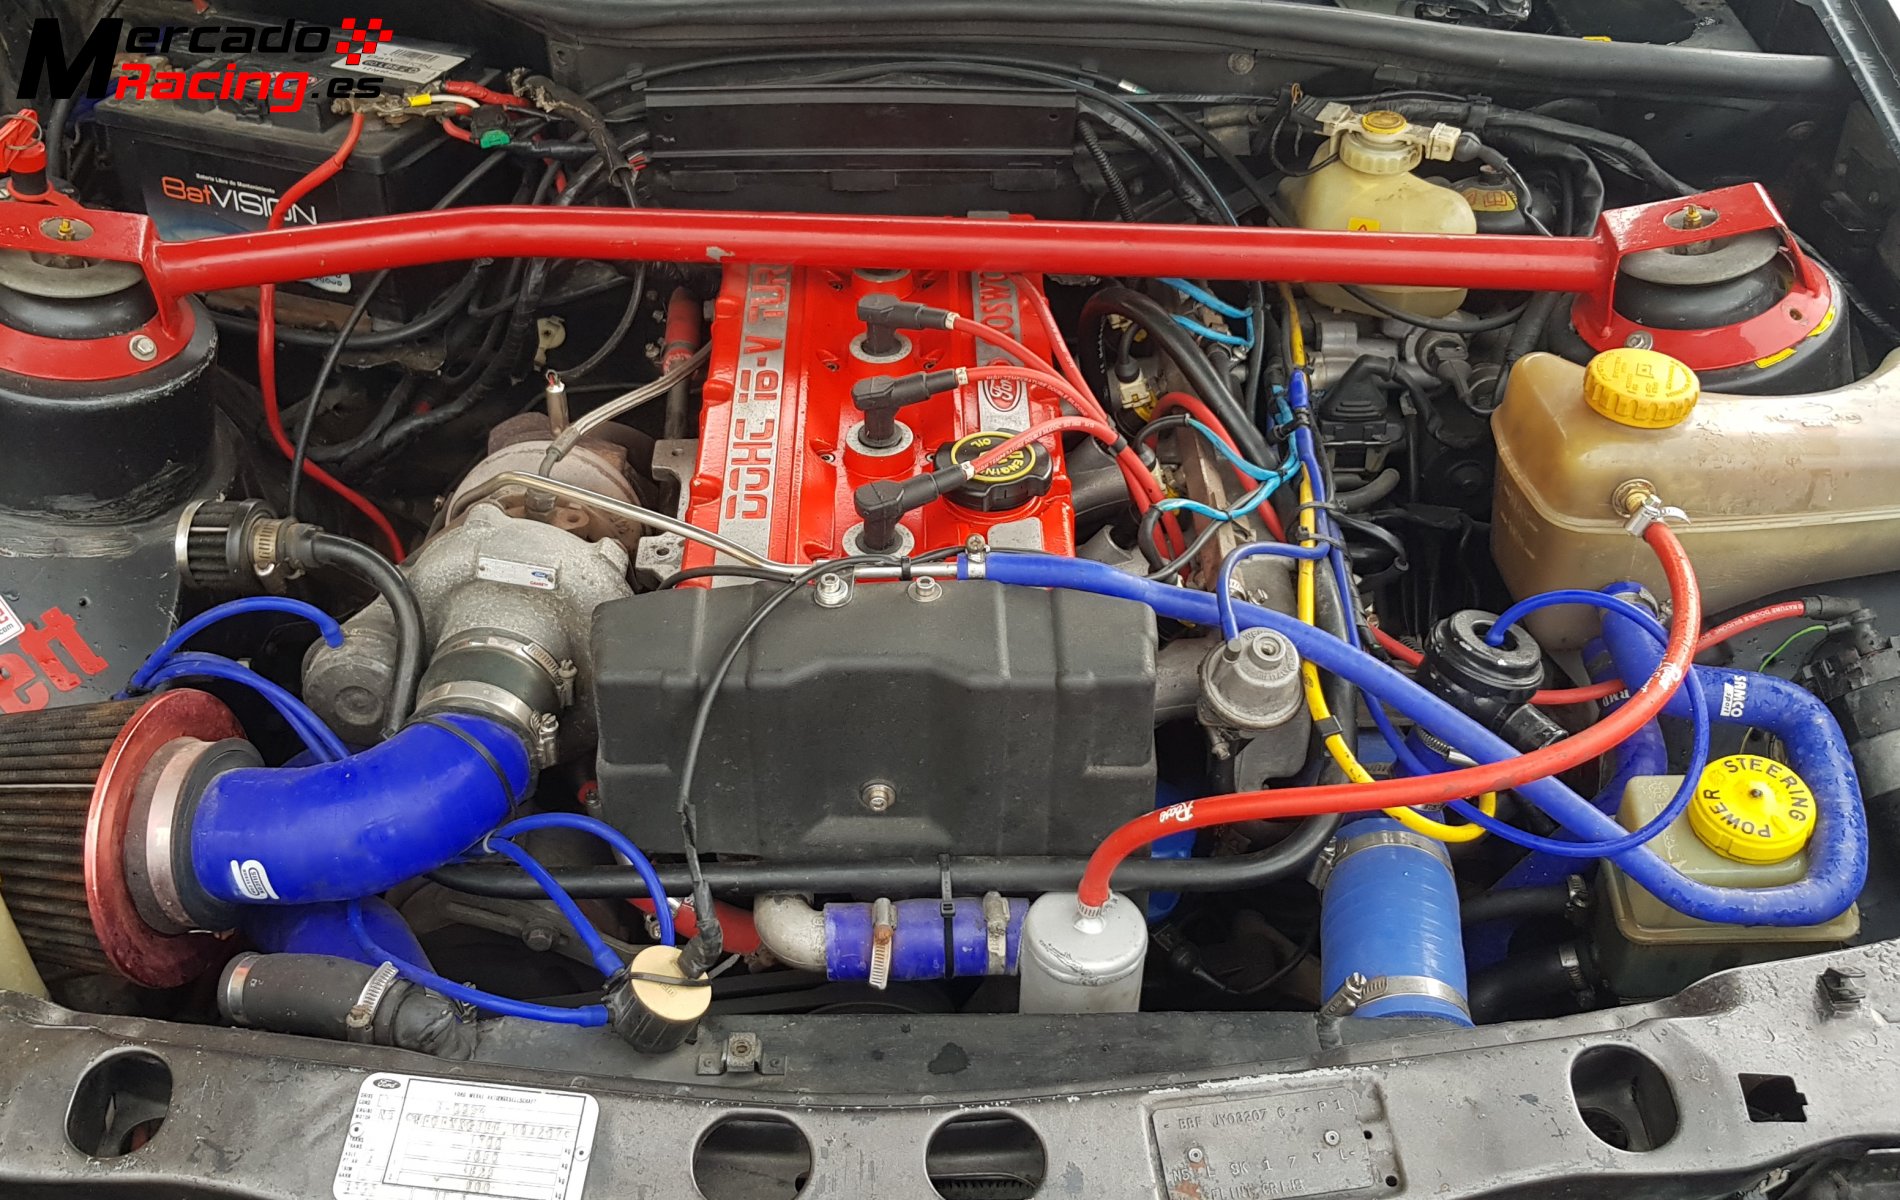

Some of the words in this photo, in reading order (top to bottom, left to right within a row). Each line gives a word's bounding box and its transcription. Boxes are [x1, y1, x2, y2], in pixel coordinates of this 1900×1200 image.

[978, 271, 1017, 333] OSWO
[970, 437, 991, 448] OIL
[725, 418, 775, 520] DOHC
[1743, 609, 1772, 621] DOUBLE
[1723, 692, 1731, 714] sport
[1731, 675, 1747, 717] SAMCO
[1723, 757, 1809, 822] STEERING
[1703, 788, 1772, 838] POWER
